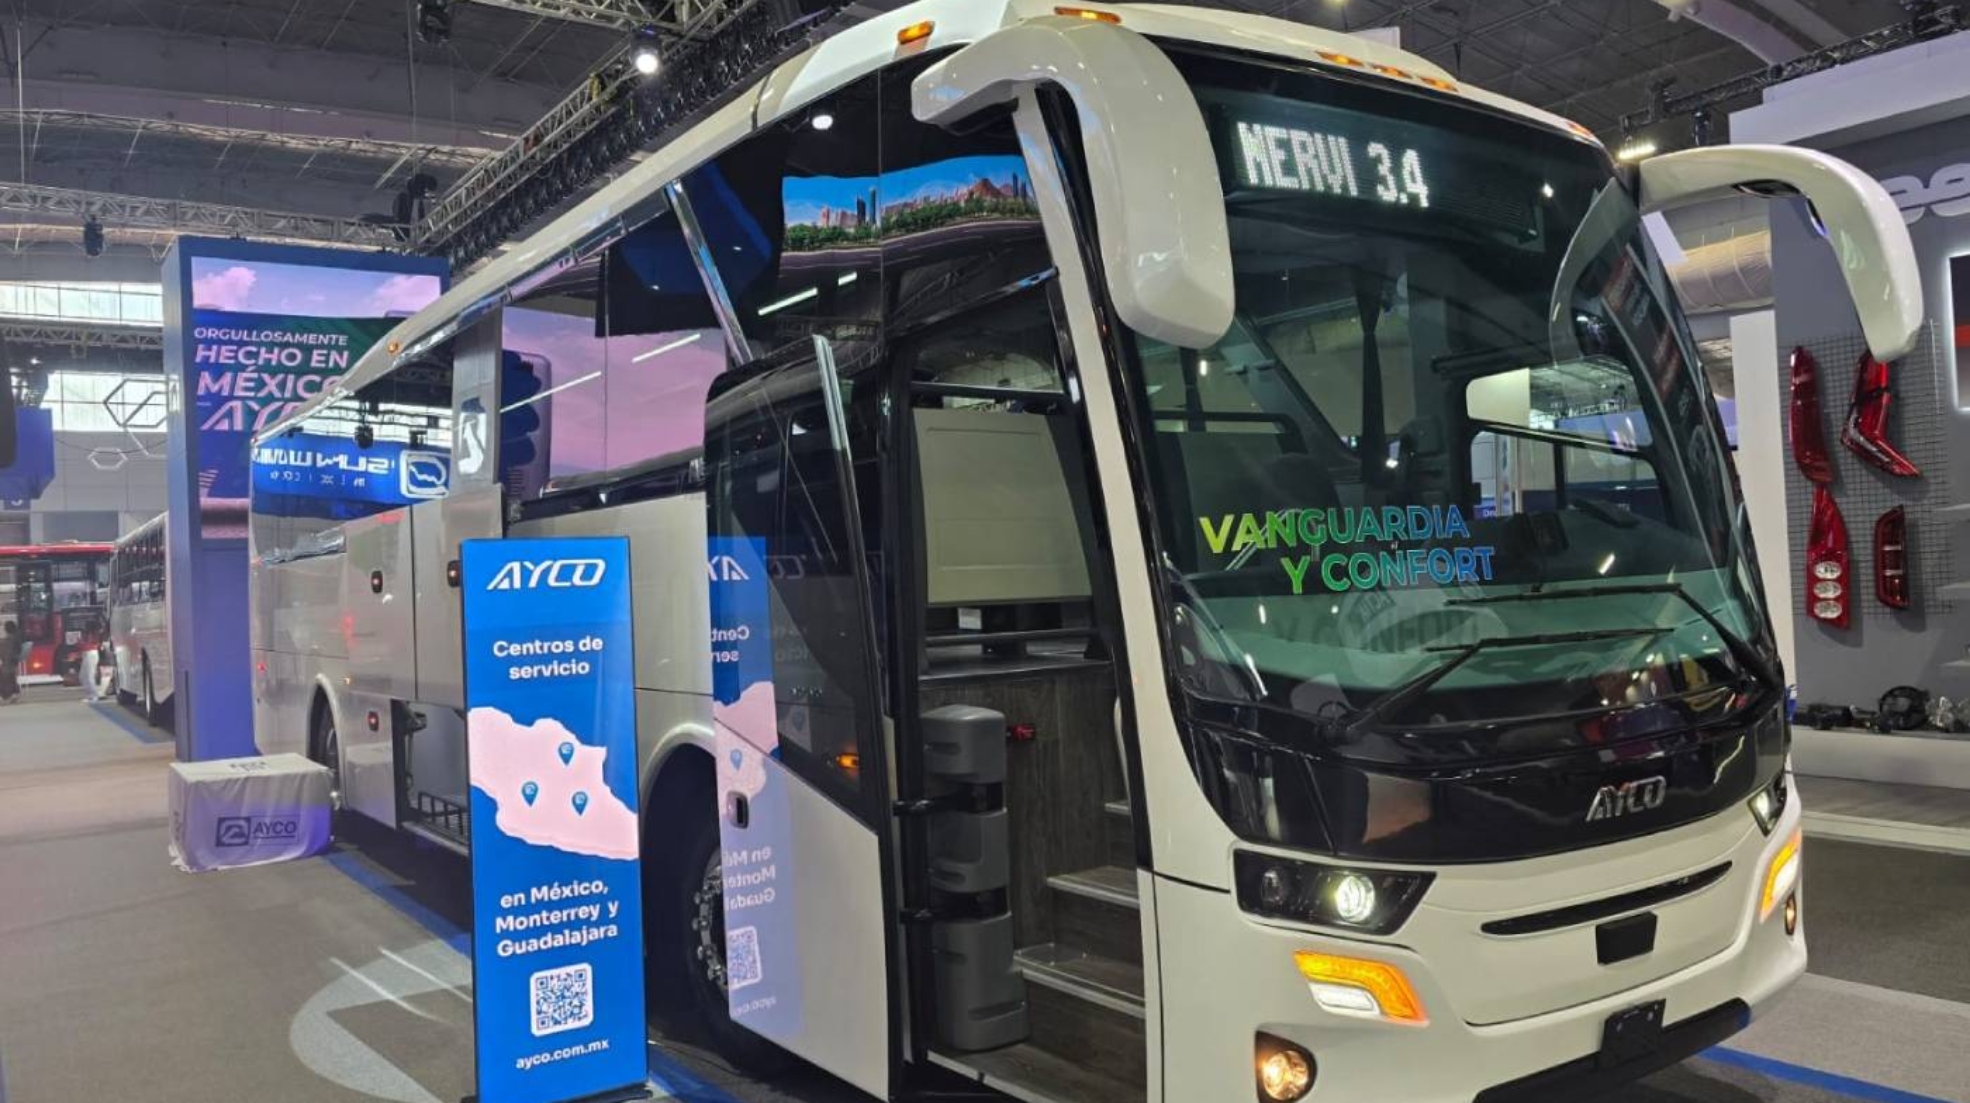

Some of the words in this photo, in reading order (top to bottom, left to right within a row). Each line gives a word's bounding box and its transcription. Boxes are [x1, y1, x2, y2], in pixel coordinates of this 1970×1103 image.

[1237, 121, 1359, 197] MERVI
[1367, 141, 1429, 208] 3.4
[194, 327, 349, 346] ORGULLOSAMENTE
[195, 344, 303, 367] HECHO
[310, 349, 349, 368] EN
[1199, 504, 1470, 554] VANGUARDIA
[486, 559, 606, 590] AYCO
[1280, 555, 1310, 594] Y
[1321, 547, 1495, 591] CONFORT
[493, 638, 574, 657] Centros
[579, 636, 603, 651] de
[509, 659, 590, 680] servicio
[1585, 775, 1667, 822] AYCO
[253, 821, 297, 835] AYCO
[500, 891, 526, 909] en
[531, 879, 608, 905] México,
[495, 901, 601, 933] Monterrey
[607, 900, 619, 919] y
[496, 924, 619, 957] Guadalajara
[515, 1038, 609, 1070] ayco.com.mx
